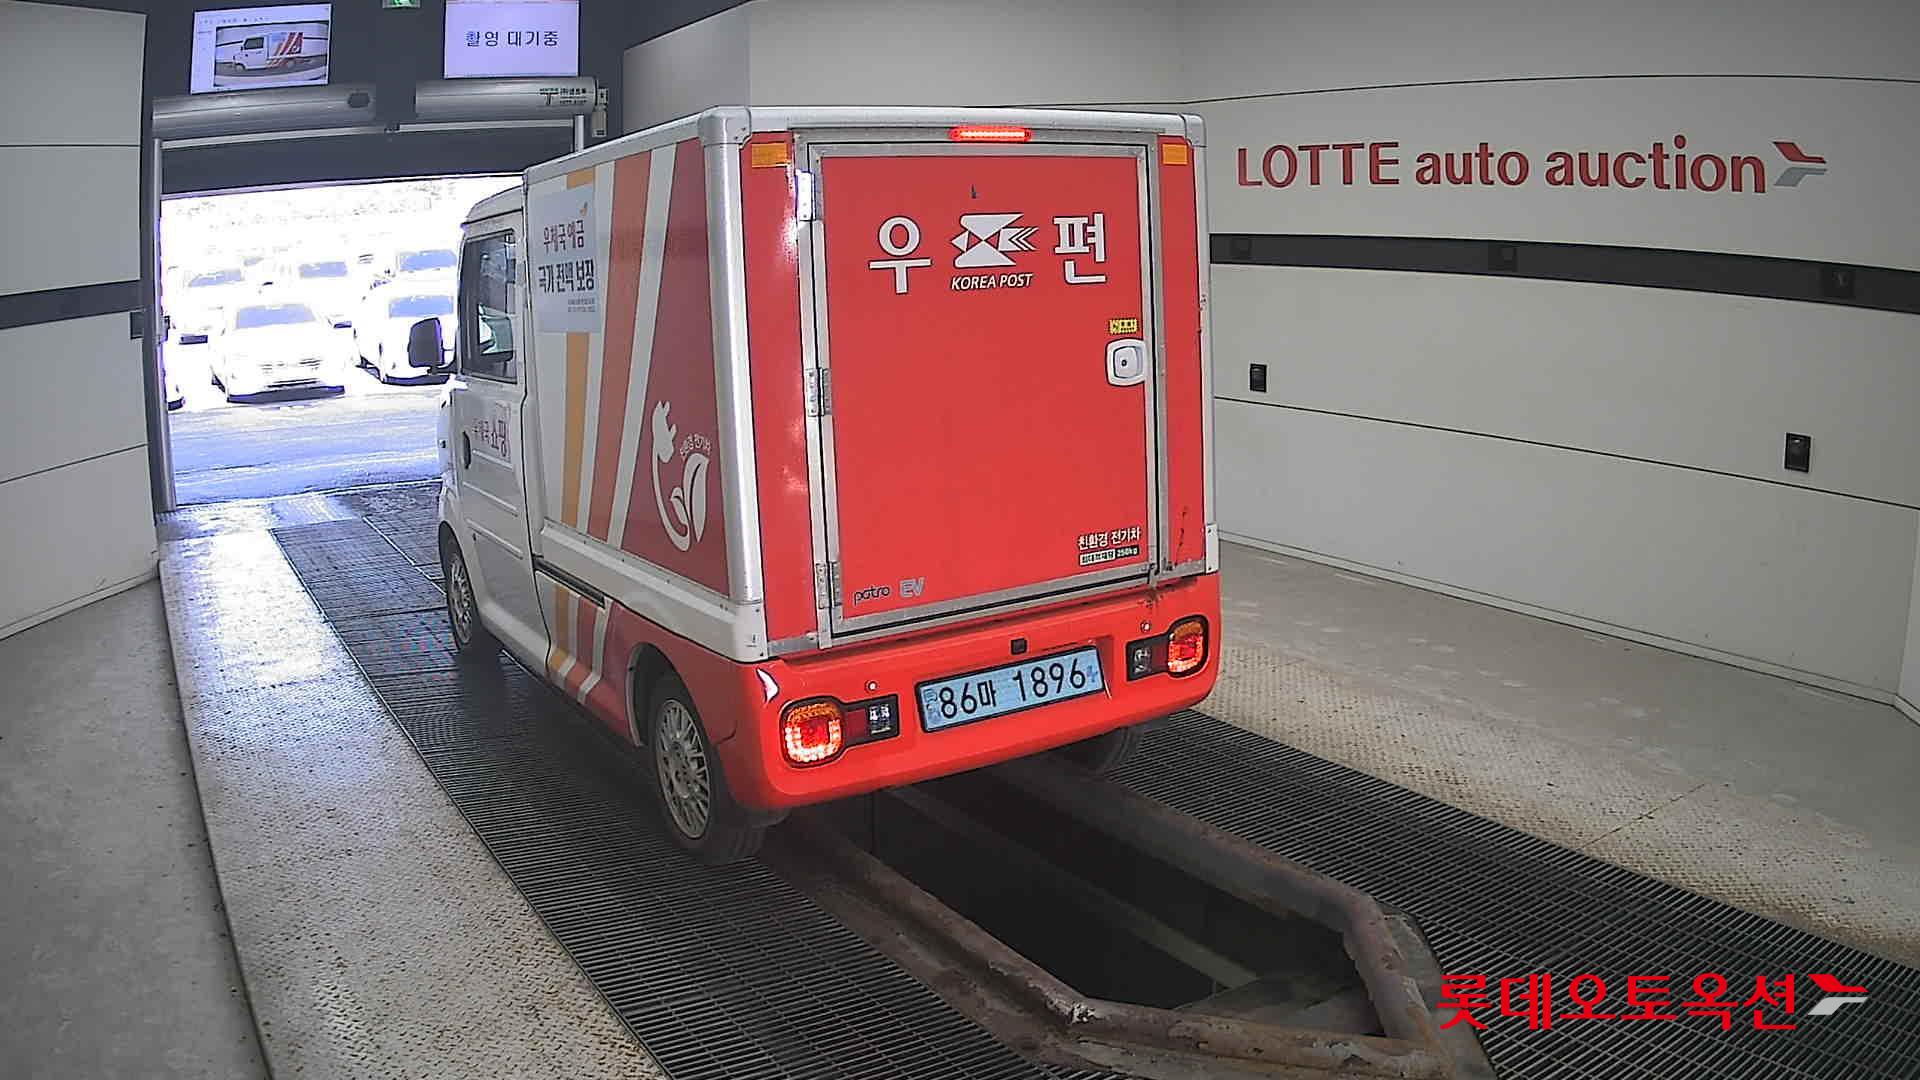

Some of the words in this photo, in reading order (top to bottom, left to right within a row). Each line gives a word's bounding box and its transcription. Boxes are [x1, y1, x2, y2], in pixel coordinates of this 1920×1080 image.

[465, 31, 498, 47] 촬영
[507, 31, 559, 47] 대기중
[1237, 142, 1400, 188] LOTTE
[1414, 142, 1530, 186] auto
[1544, 134, 1767, 194] auction
[575, 258, 595, 292] 보장
[950, 275, 997, 291] KOREA
[999, 272, 1034, 288] POST
[1078, 531, 1108, 551] 친환경
[1110, 526, 1141, 545] 전기차
[900, 576, 925, 598] EV
[938, 679, 997, 719] 86마
[1012, 657, 1086, 702] 1896
